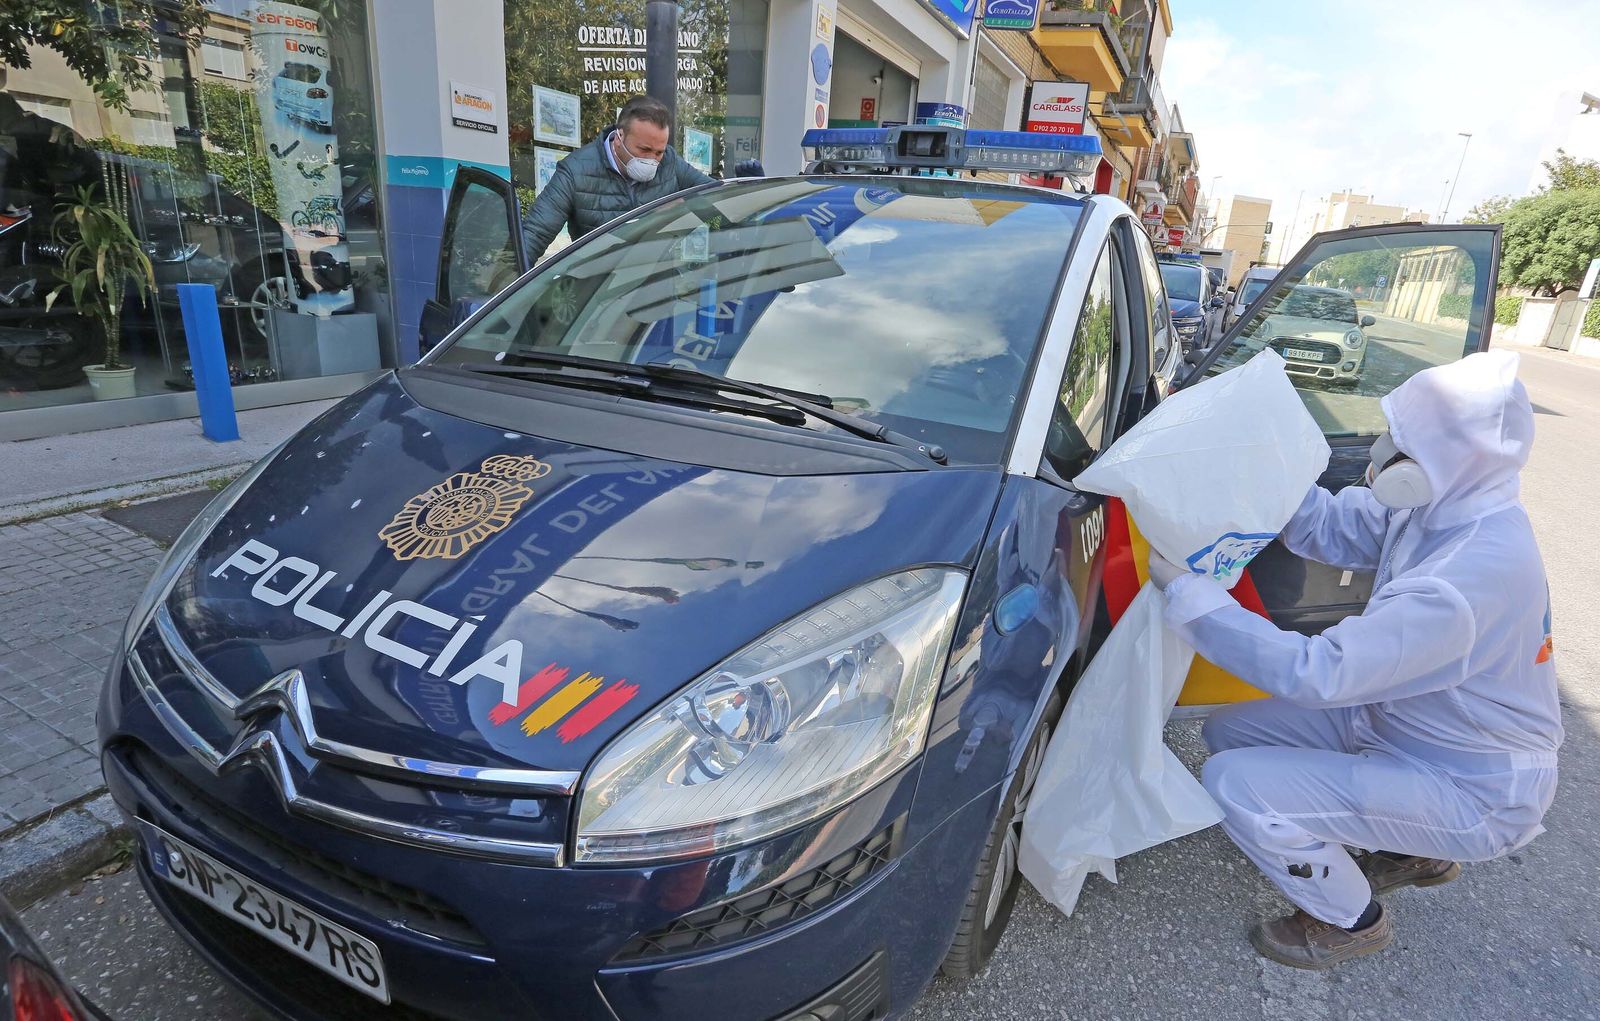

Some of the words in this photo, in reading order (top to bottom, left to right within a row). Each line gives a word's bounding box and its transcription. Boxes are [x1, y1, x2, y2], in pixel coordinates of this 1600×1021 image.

[578, 25, 631, 45] OFERTA
[583, 57, 647, 72] REVISION
[583, 80, 599, 94] DE
[602, 79, 627, 93] AIRE
[1033, 103, 1082, 113] CARGLASS
[456, 120, 477, 129] SERVICIO
[477, 124, 495, 132] OFICIAL
[417, 523, 448, 537] POLICIA
[210, 538, 523, 708] POLICÍA
[159, 835, 223, 899] CNP
[224, 872, 317, 952] 2347
[320, 923, 381, 988] RS
